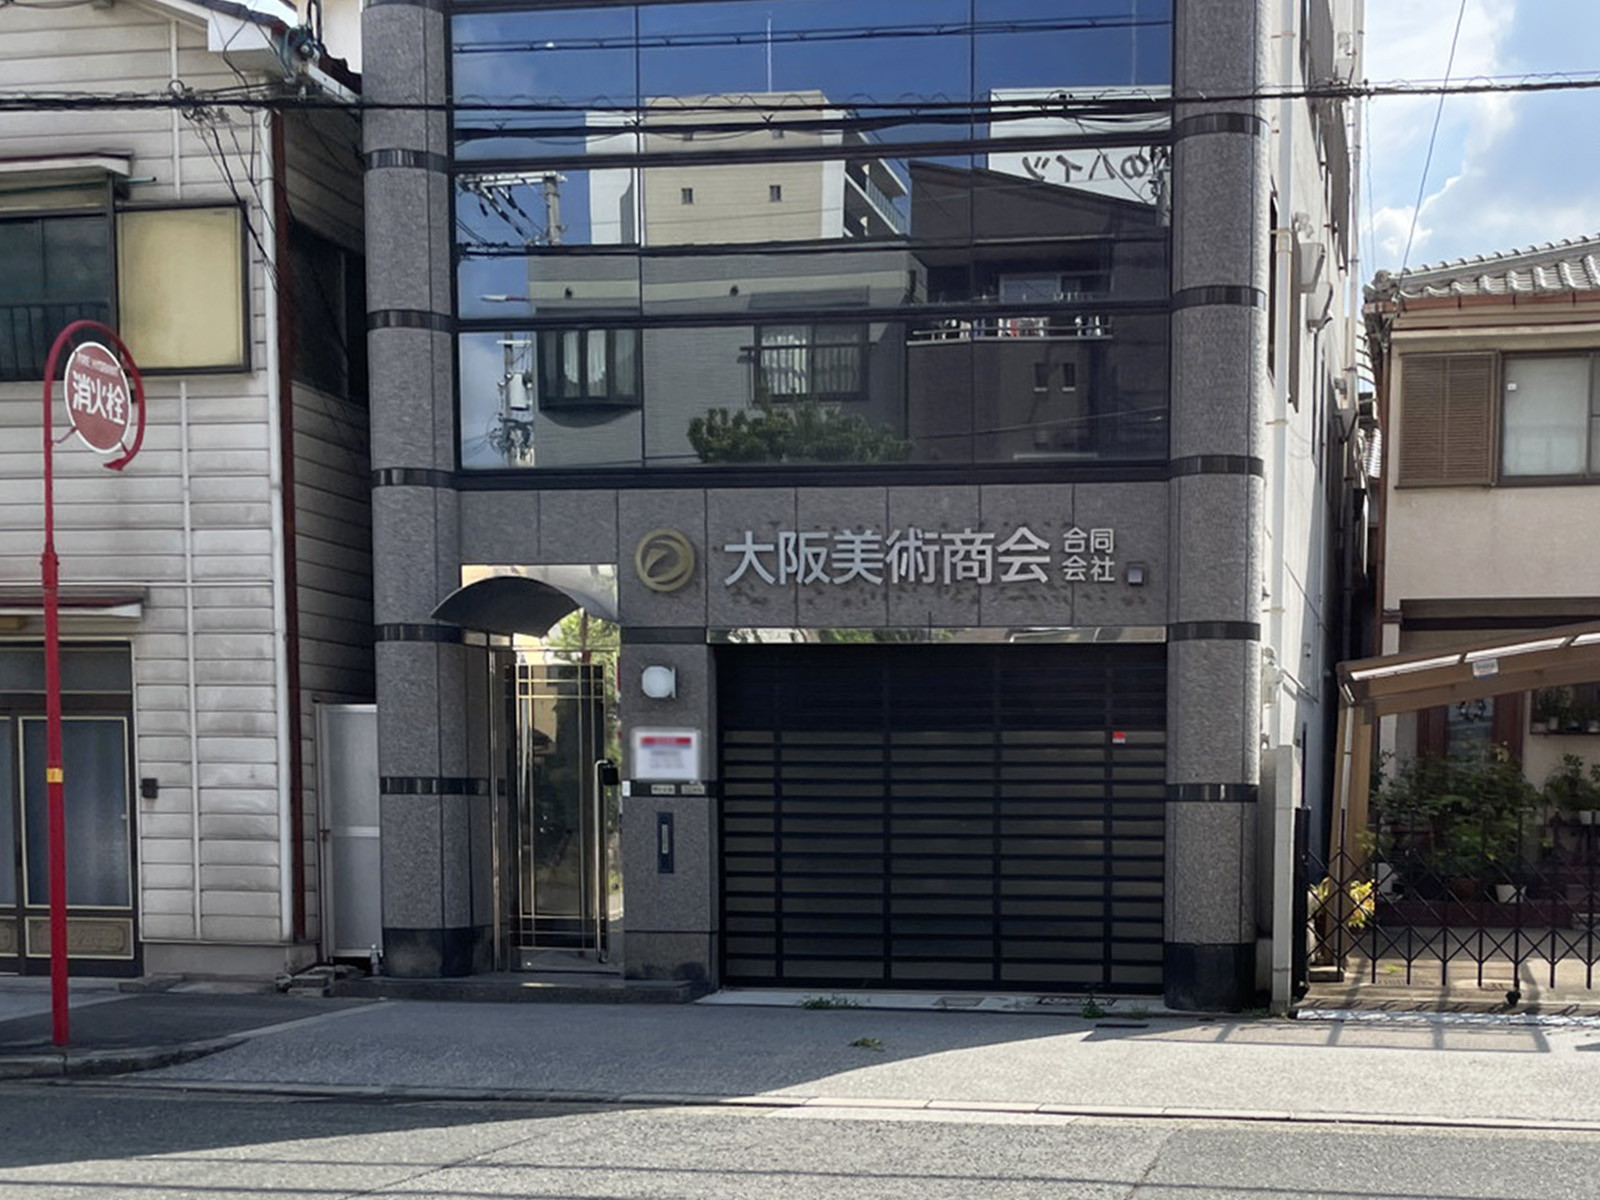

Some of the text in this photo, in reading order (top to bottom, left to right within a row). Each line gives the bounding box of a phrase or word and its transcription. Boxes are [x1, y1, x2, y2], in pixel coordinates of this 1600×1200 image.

[72, 370, 125, 425] 消火栓
[724, 526, 1051, 585] 大阪美術商会
[1063, 527, 1114, 553] 合同
[1062, 555, 1115, 581] 会社
